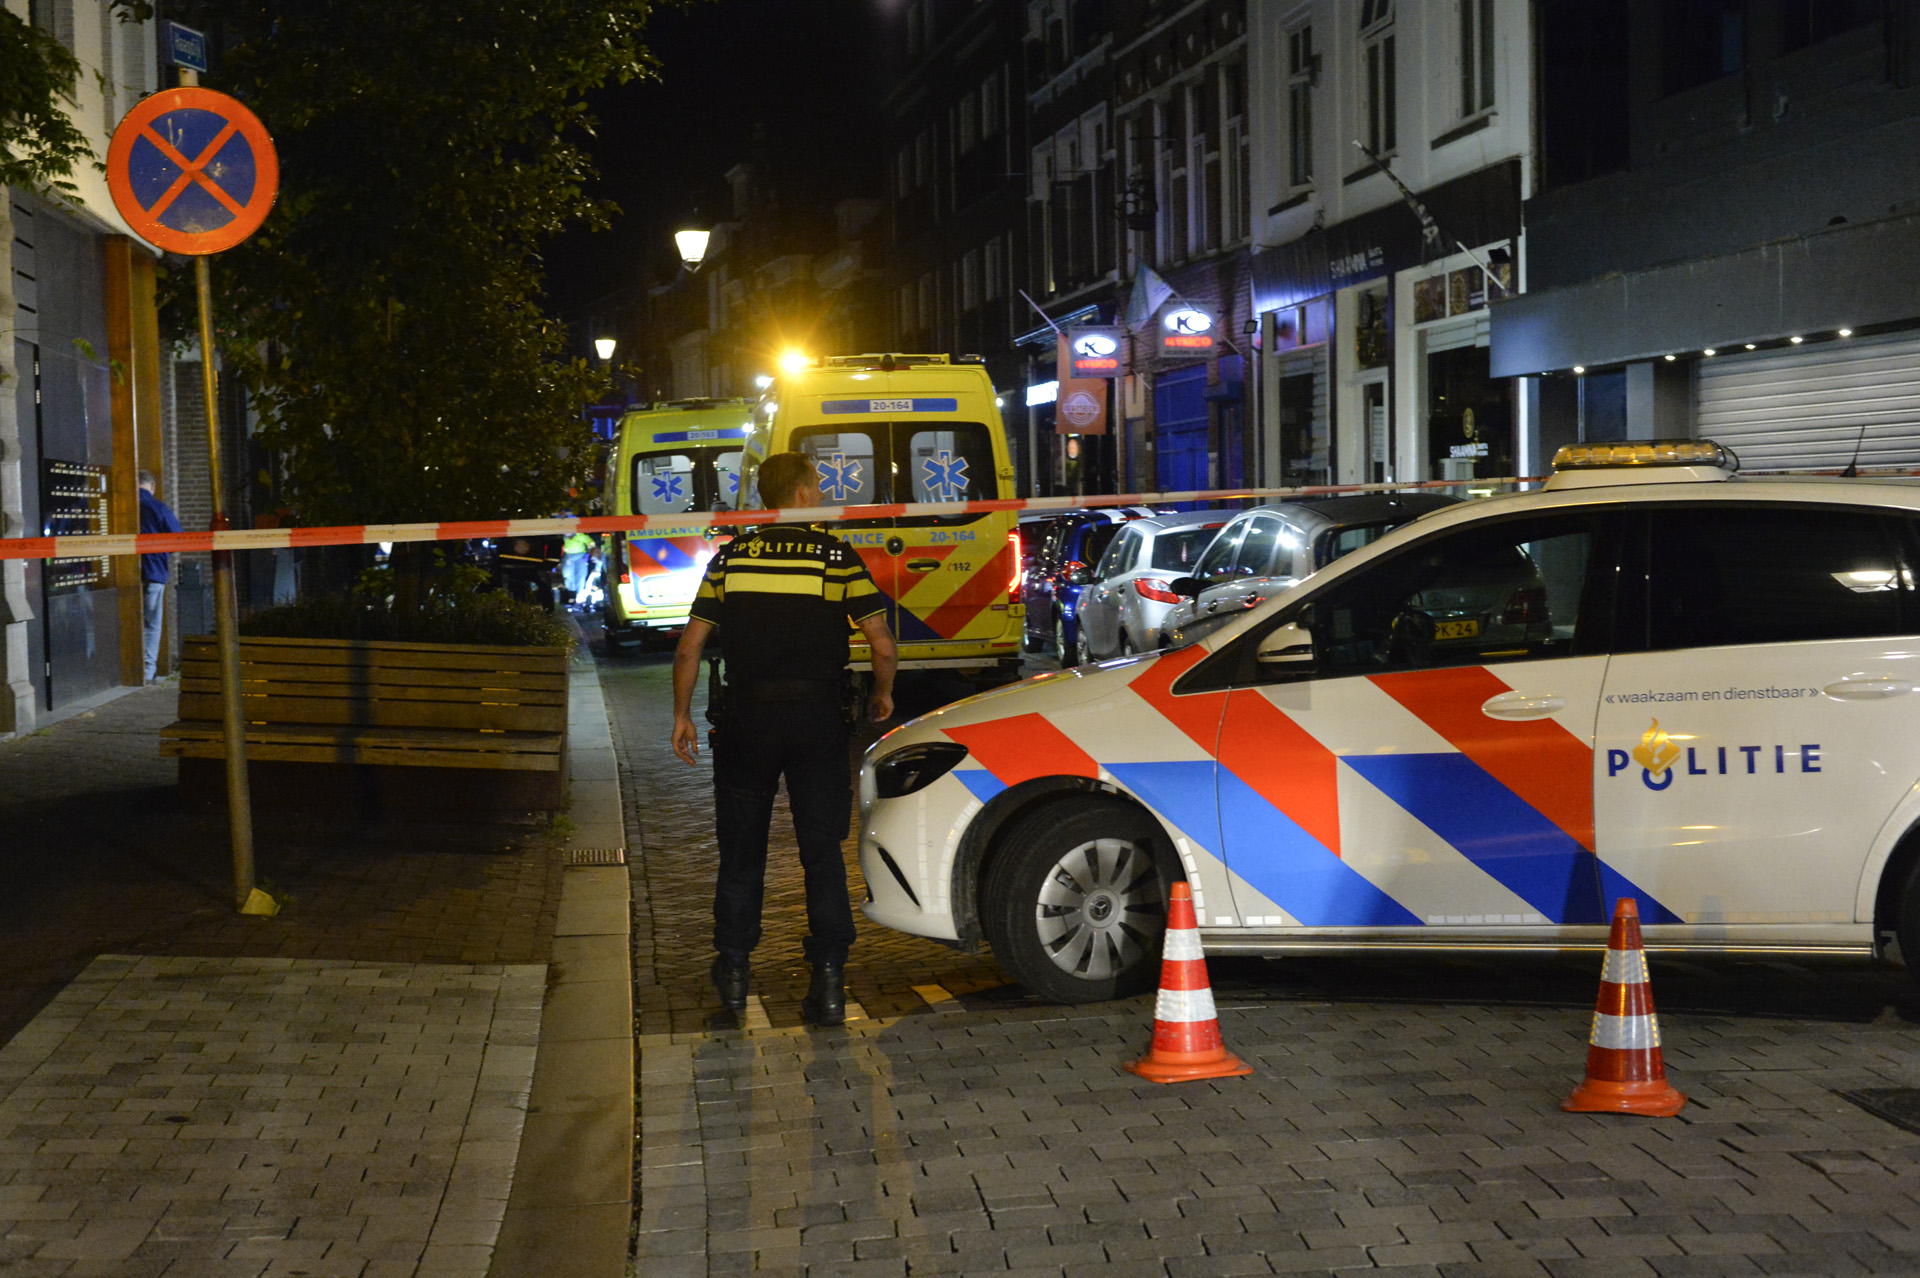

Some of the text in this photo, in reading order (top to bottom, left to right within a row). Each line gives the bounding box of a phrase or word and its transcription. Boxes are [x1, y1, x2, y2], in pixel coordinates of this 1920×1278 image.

[873, 401, 910, 410] 20-164
[628, 526, 701, 538] AMBULANCE
[930, 531, 976, 542] 20-164
[842, 533, 884, 544] ANCE
[738, 541, 816, 558] POLITIE
[952, 563, 971, 571] 112
[1618, 689, 1698, 704] waakzaam
[1702, 690, 1721, 701] en
[1723, 685, 1806, 701] dienstbaar
[1608, 743, 1821, 791] POLITIE
